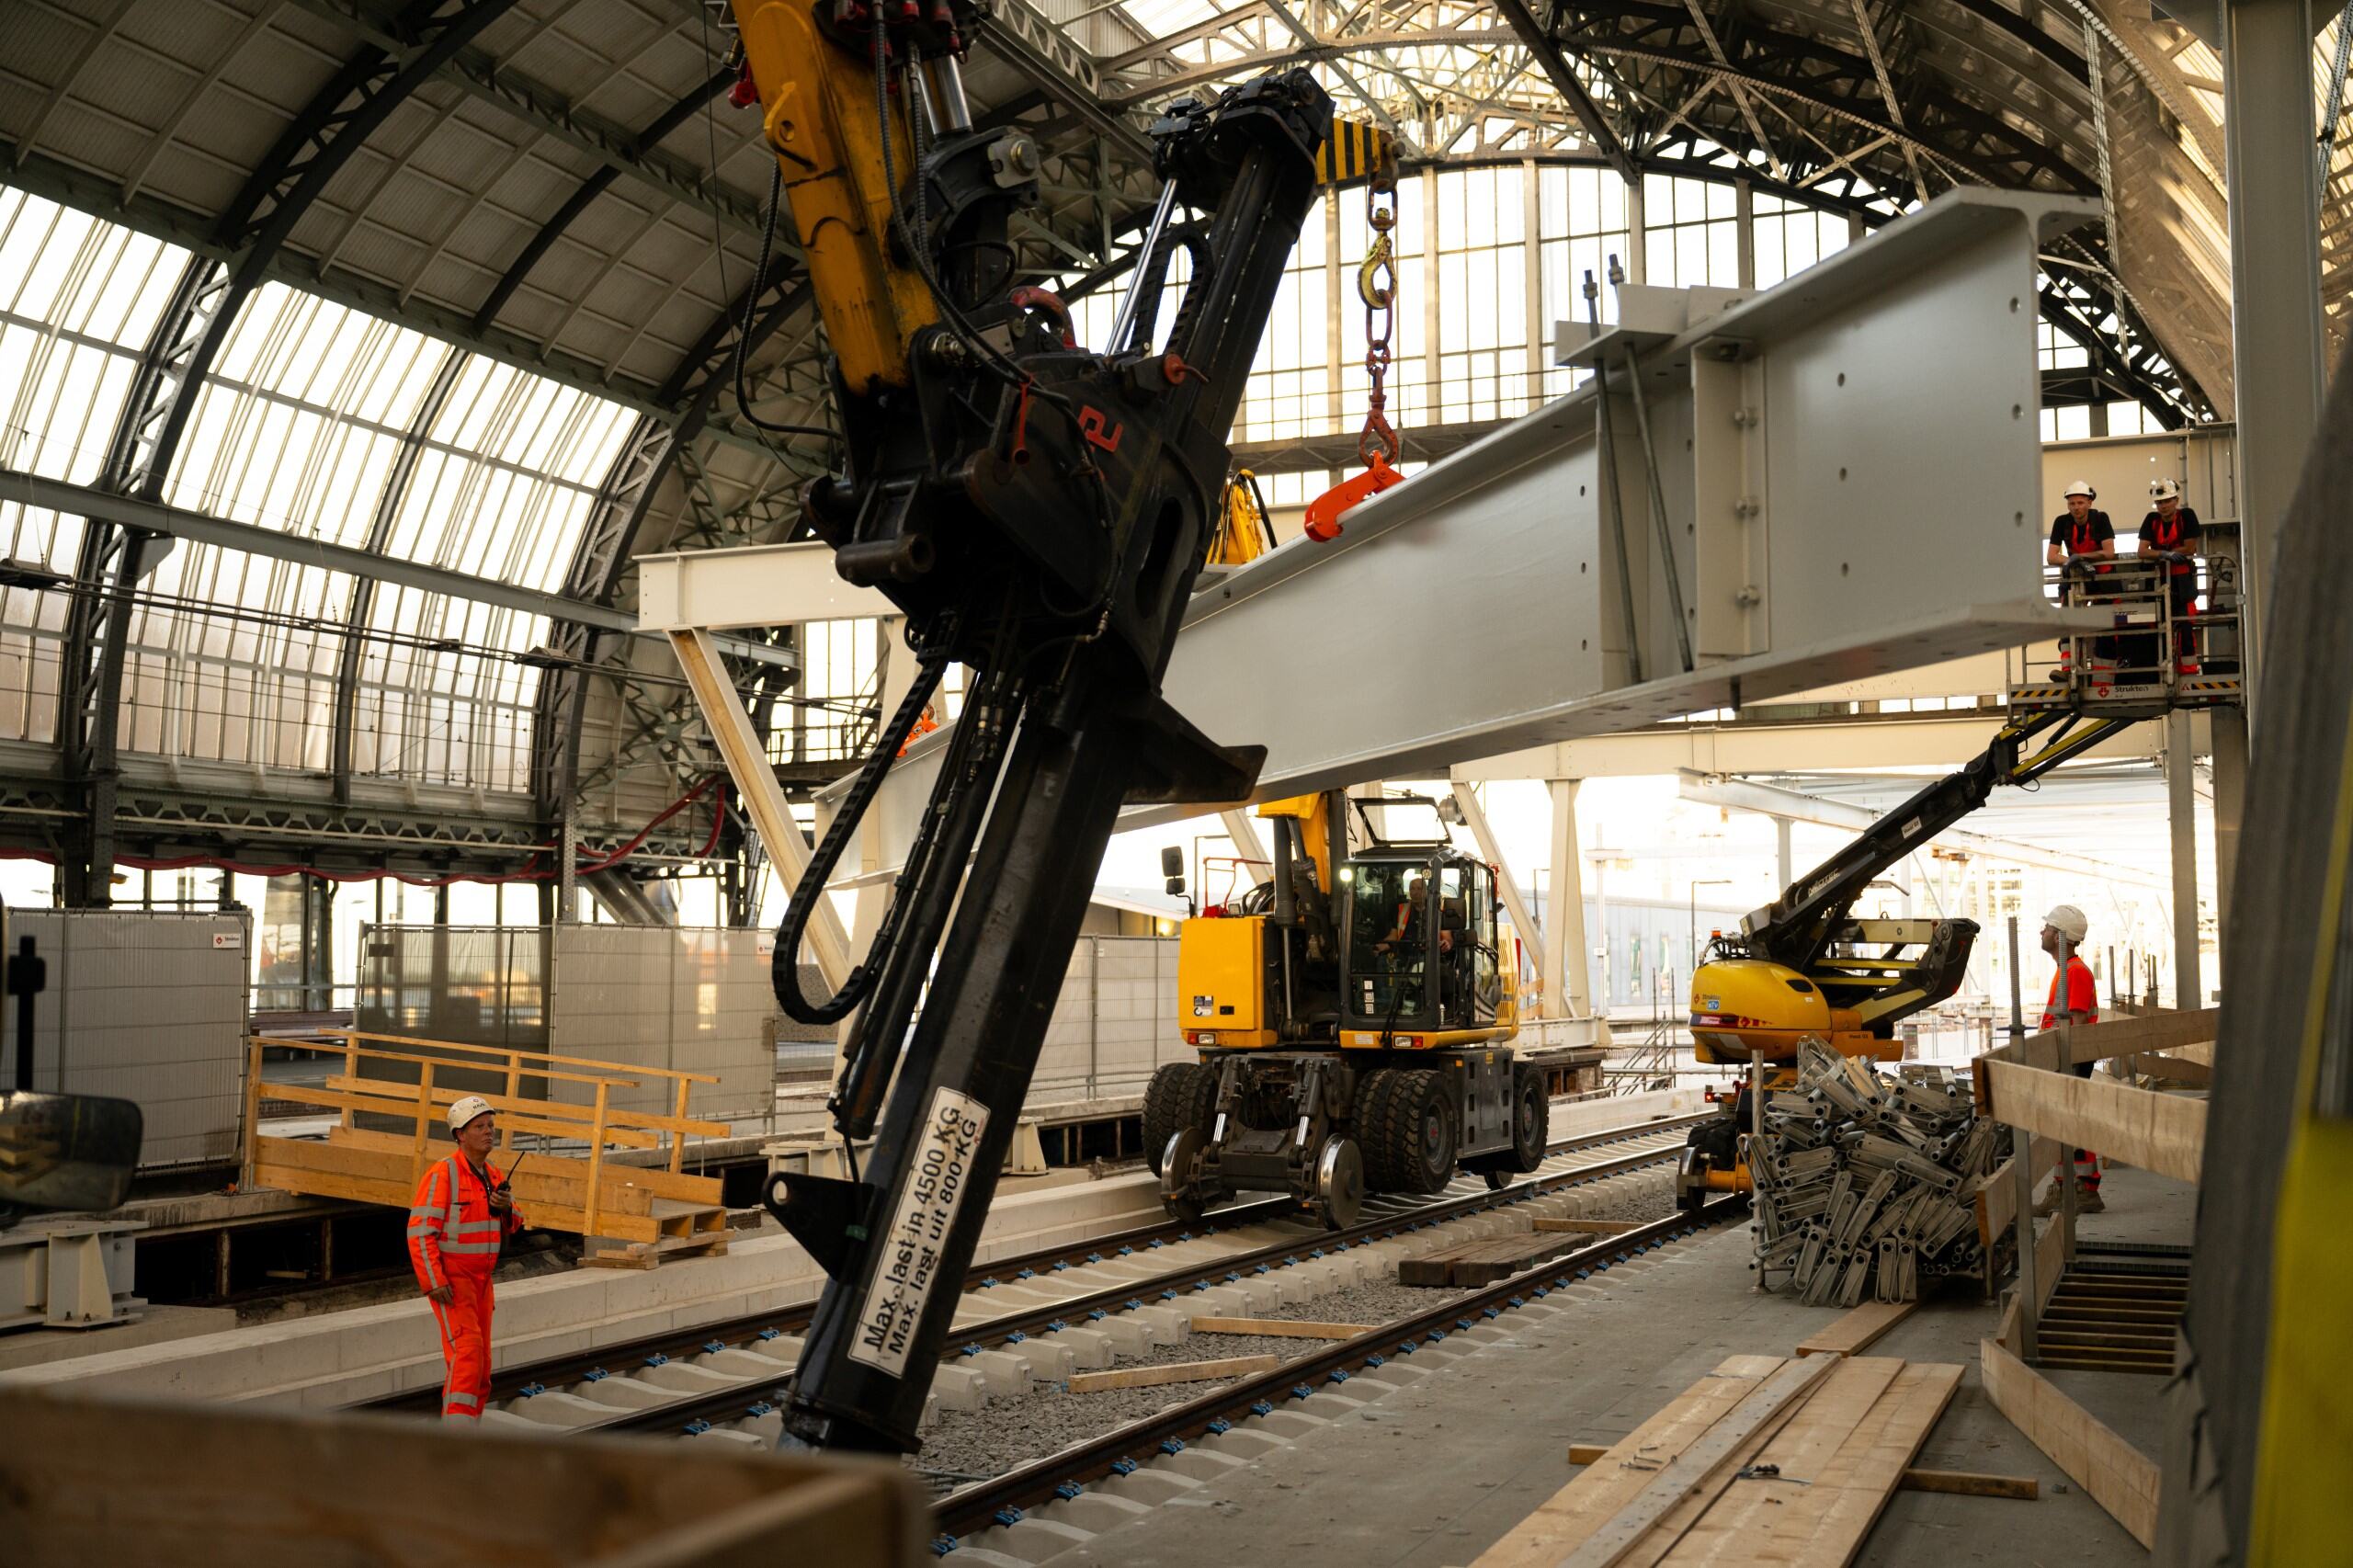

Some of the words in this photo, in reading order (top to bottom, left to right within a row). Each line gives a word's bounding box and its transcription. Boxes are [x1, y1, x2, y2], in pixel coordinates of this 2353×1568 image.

[863, 1292, 899, 1352] Max.
[885, 1238, 917, 1285] last
[902, 1210, 926, 1236] in
[914, 1149, 946, 1205] 4500
[933, 1107, 961, 1144] KG
[888, 1300, 919, 1355] Max.
[909, 1245, 935, 1291] last
[929, 1208, 948, 1241] uit
[939, 1161, 963, 1204] 800
[954, 1119, 978, 1157] KG
